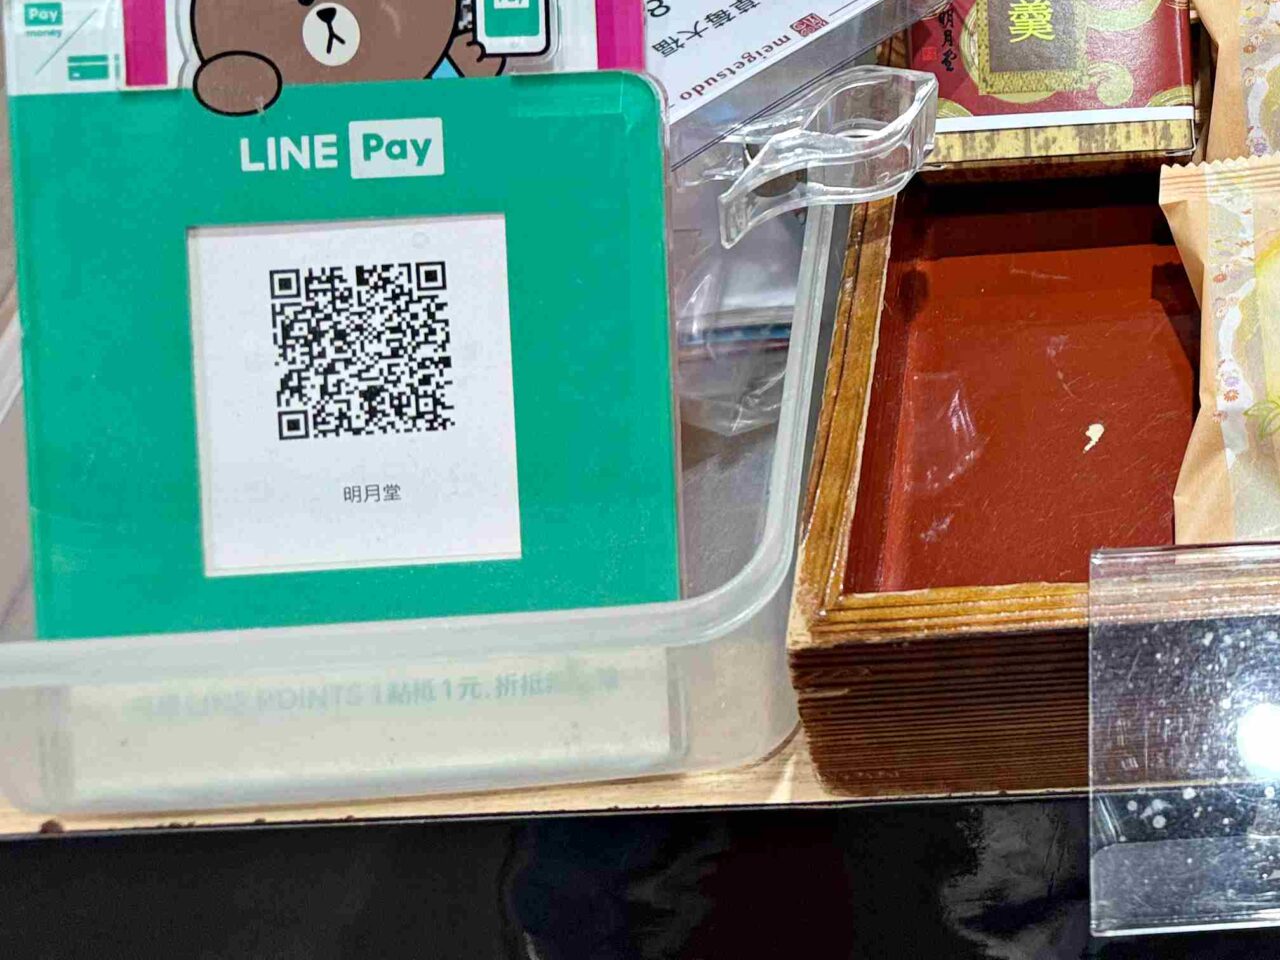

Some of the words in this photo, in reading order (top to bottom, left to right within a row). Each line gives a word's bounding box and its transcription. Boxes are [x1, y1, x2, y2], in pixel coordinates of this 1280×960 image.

[28, 7, 59, 23] Pay
[679, 34, 792, 102] meigetsudo
[239, 133, 338, 172] LINE
[362, 132, 432, 167] Pay
[343, 483, 401, 503] 明月堂
